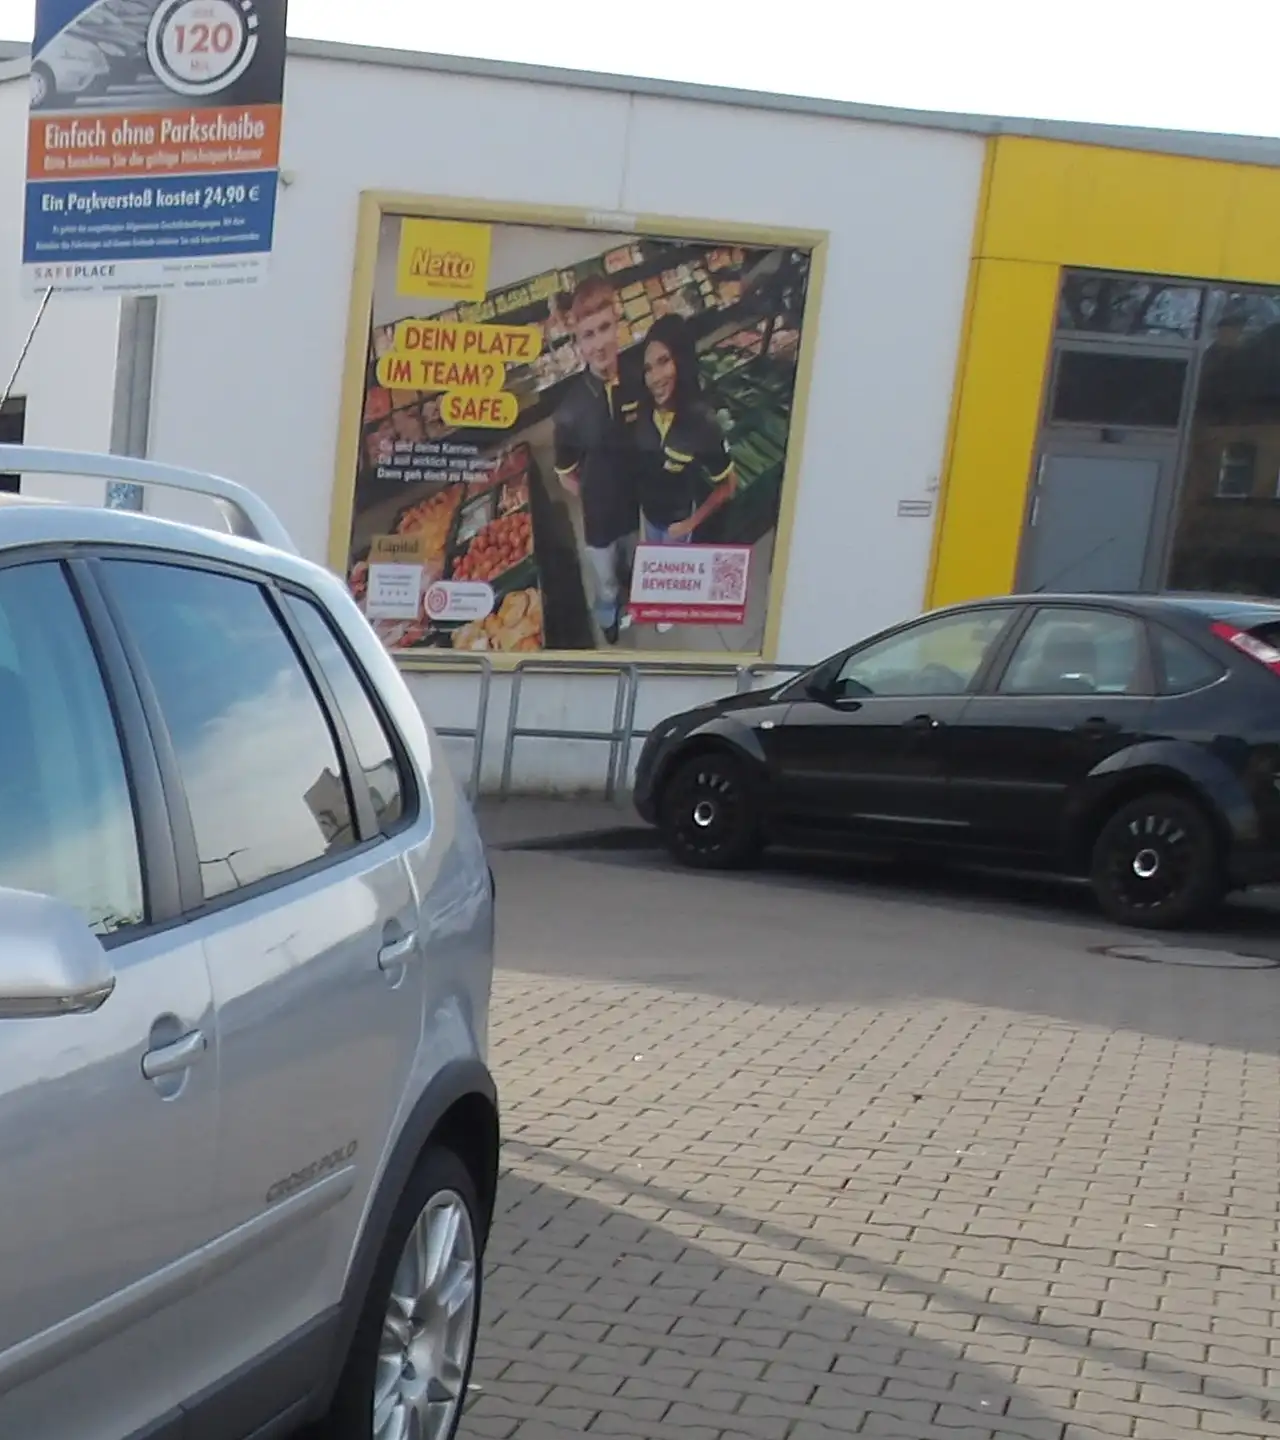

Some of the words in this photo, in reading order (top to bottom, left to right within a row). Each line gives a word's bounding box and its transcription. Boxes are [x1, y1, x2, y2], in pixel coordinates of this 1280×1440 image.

[175, 22, 233, 54] 120
[44, 119, 105, 149] Einfach
[112, 118, 154, 146] ohne
[161, 112, 264, 144] Parkscheibe
[42, 194, 63, 211] Ein
[68, 188, 152, 211] Parkverstoß
[156, 189, 200, 207] kostet
[204, 185, 245, 208] 24,90
[248, 186, 260, 201] €
[410, 246, 475, 280] Netto
[405, 326, 456, 352] DEIN
[464, 328, 531, 357] PLATZ
[387, 359, 412, 383] IM
[421, 360, 494, 388] TEAM?
[377, 538, 419, 555] Capital
[642, 561, 696, 575] SCANNEN
[642, 577, 702, 591] BEWERBEN
